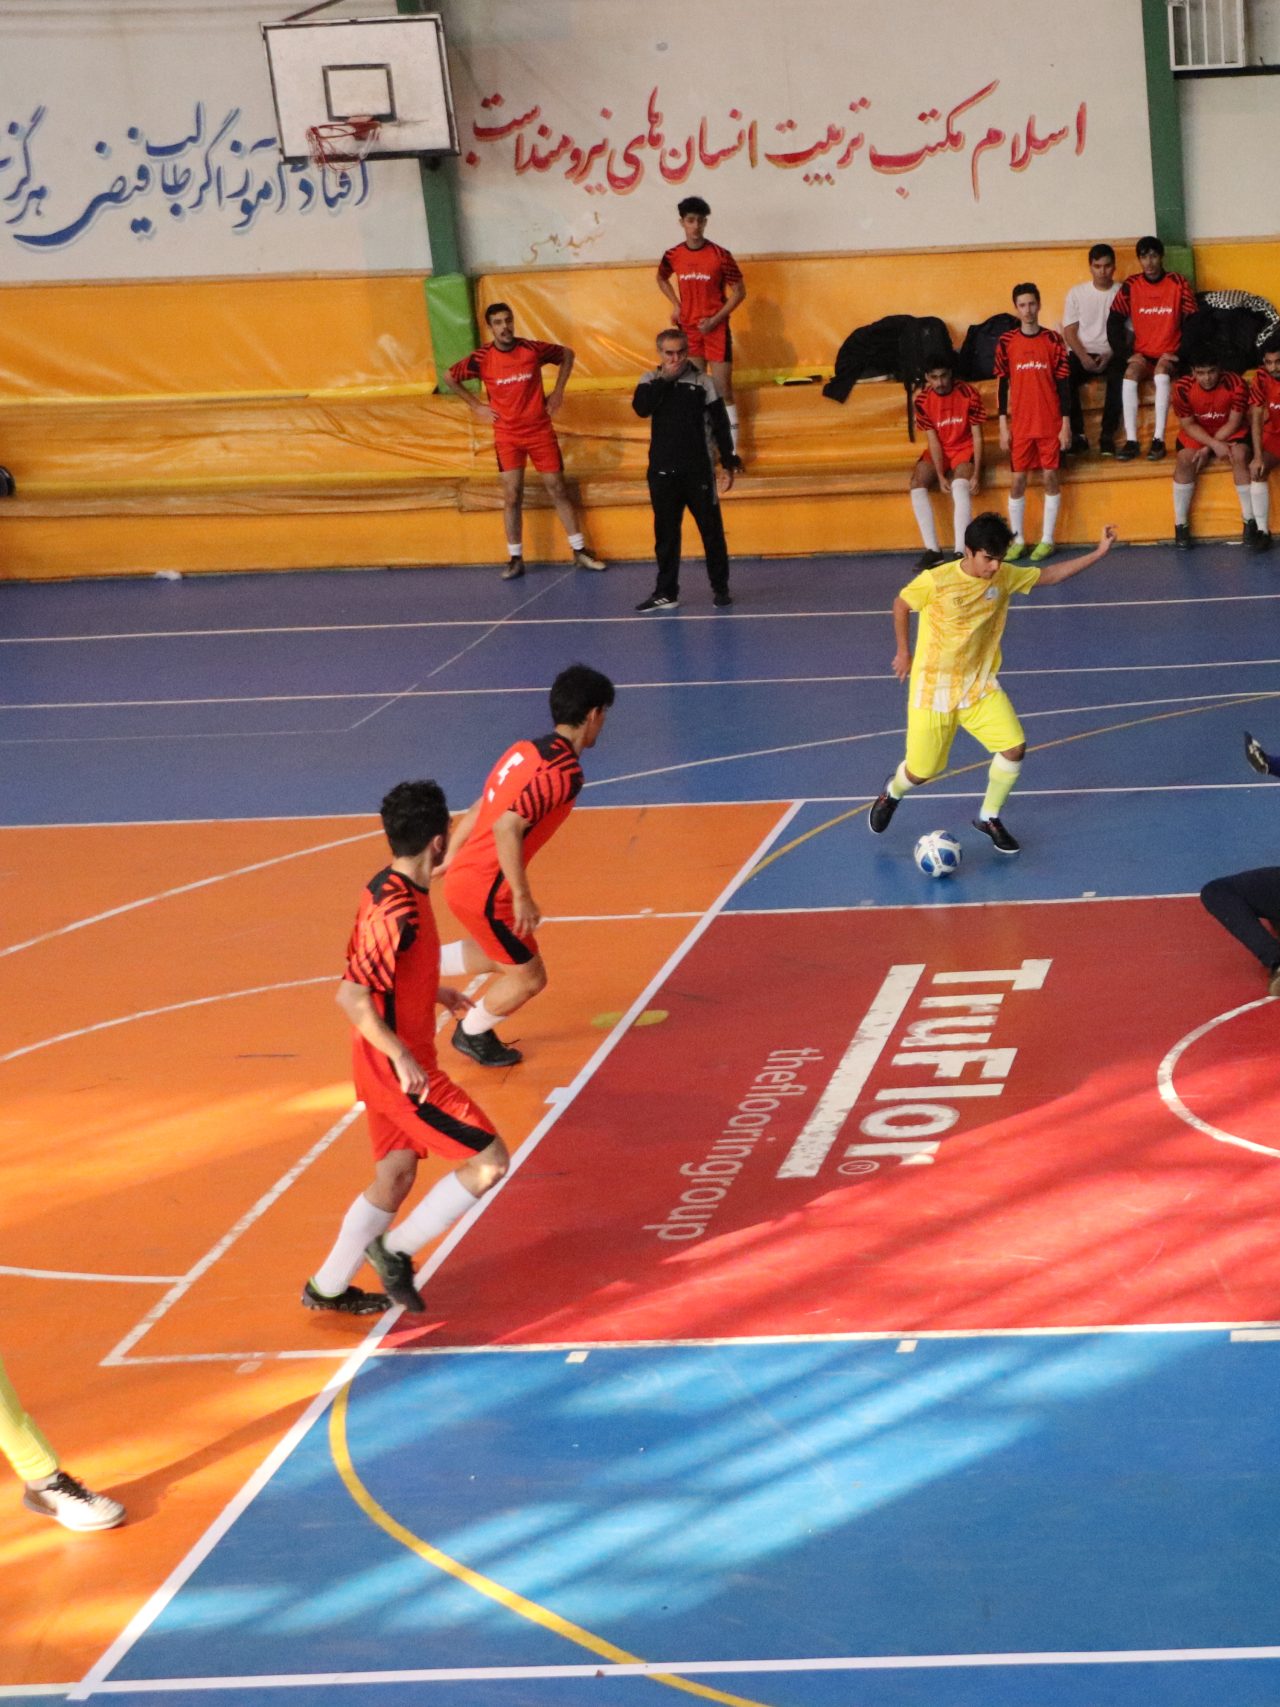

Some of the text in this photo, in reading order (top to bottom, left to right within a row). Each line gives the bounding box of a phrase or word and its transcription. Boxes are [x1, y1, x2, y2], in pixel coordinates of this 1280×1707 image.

[606, 86, 664, 196] های
[659, 108, 759, 186] انسان
[764, 97, 872, 187] تربیت
[869, 79, 1001, 199] مکتب
[971, 101, 1089, 202] اسلام
